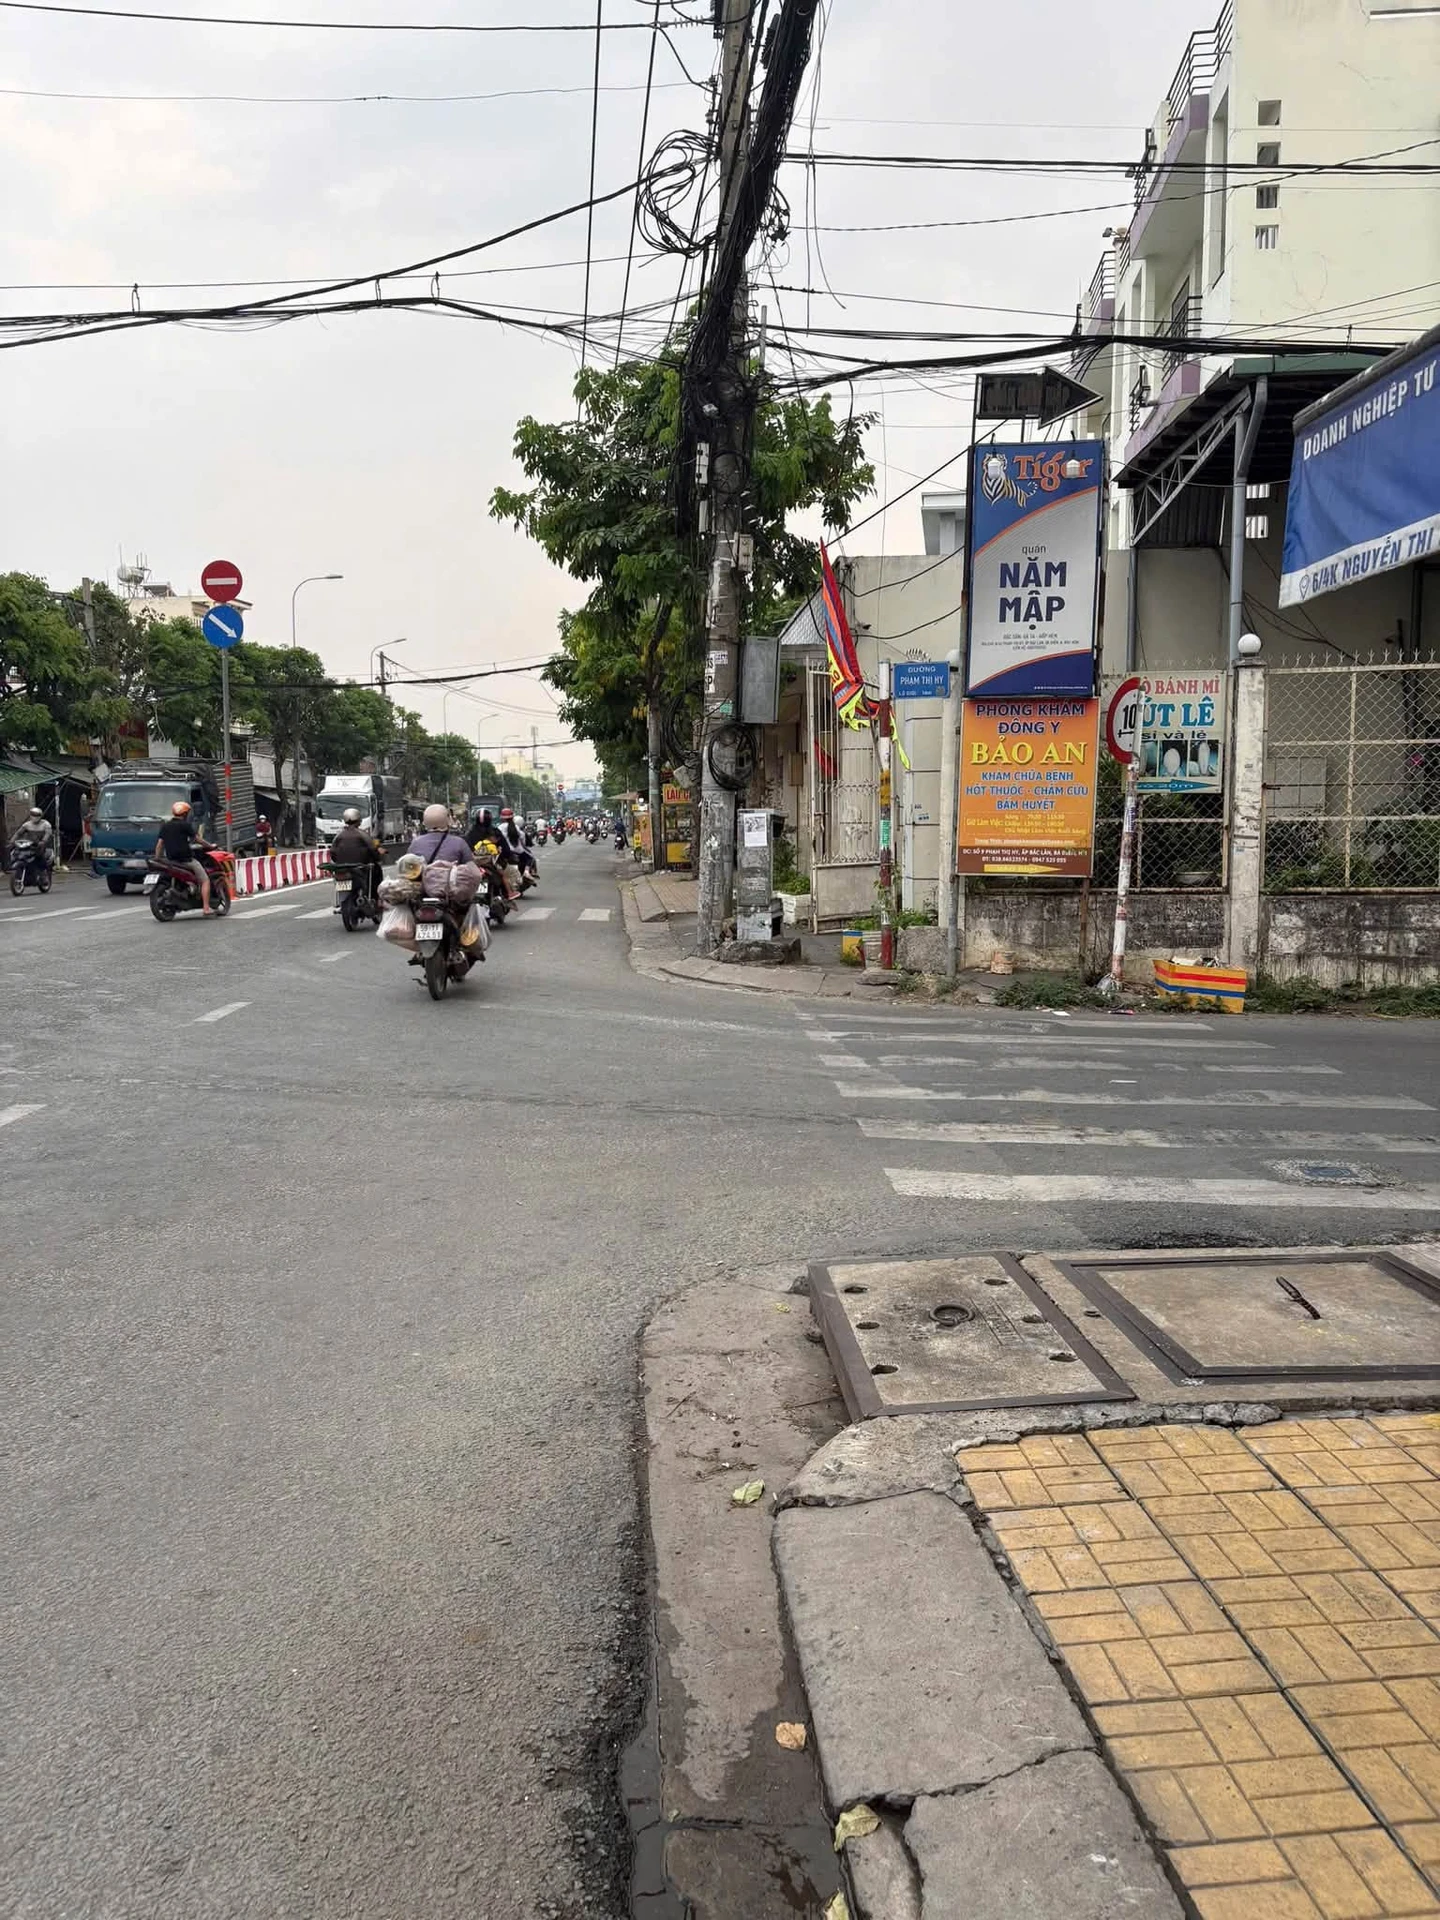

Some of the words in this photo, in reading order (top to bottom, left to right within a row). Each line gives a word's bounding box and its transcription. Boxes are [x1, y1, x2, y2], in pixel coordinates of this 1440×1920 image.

[1303, 415, 1347, 461] DOANH
[1352, 380, 1408, 433] NGHIỆP
[1414, 359, 1437, 397] TƯ
[999, 557, 1067, 588] NĂM
[1312, 564, 1339, 593] 6/4K
[999, 590, 1066, 631] MẬP
[900, 676, 920, 687] PHẠM
[1155, 675, 1198, 695] BÁNH
[1122, 703, 1138, 730] 10
[1142, 694, 1175, 727] ÚT
[1181, 694, 1215, 727] LÊ
[998, 718, 1045, 734] ĐÔNG
[1050, 720, 1061, 734] Y
[1163, 730, 1185, 740] và
[970, 735, 1034, 766] BẢO
[1040, 741, 1088, 766] AN
[981, 769, 1011, 781] KHÁM
[990, 783, 1024, 796] THUỐC
[996, 798, 1018, 811] BẤM
